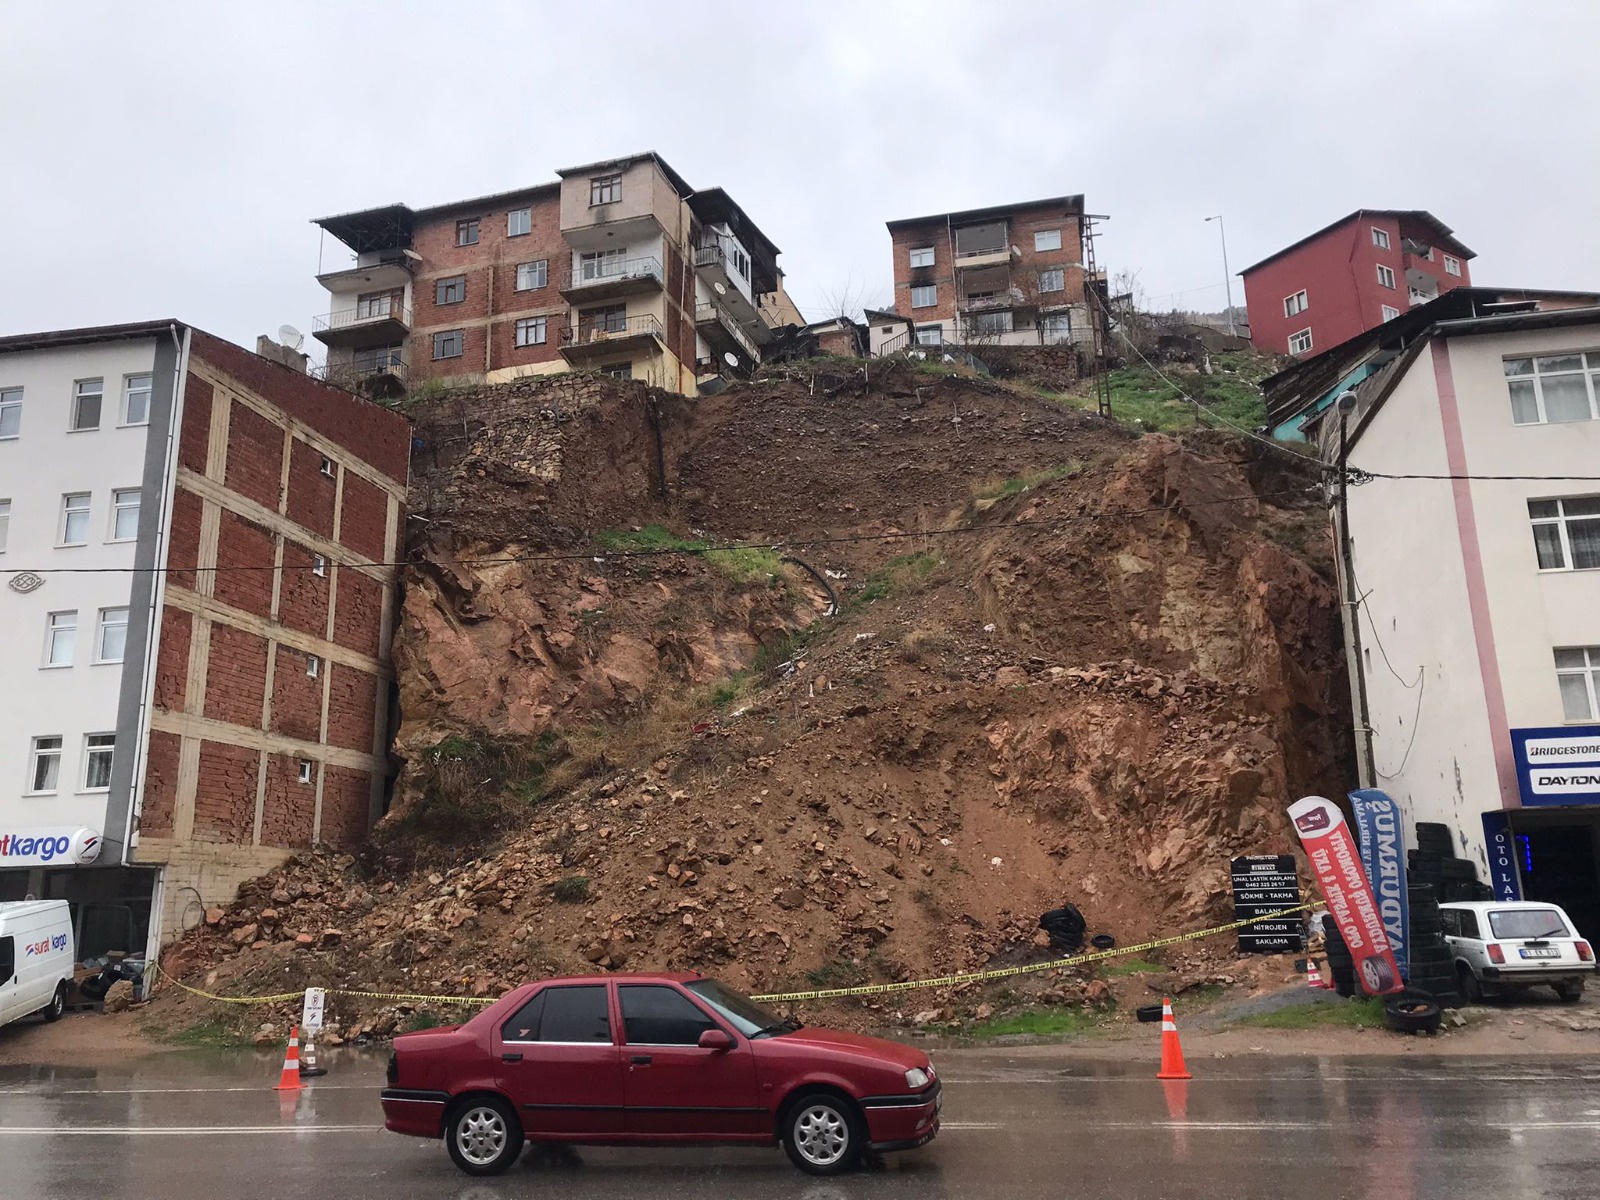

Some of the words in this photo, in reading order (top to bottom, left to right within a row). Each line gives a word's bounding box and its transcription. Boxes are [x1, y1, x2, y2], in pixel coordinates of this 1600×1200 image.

[1530, 745, 1600, 756] BRIDGESTONE
[1538, 776, 1600, 786] DAYTON
[0, 835, 70, 860] tkargo
[1495, 834, 1508, 866] OTO
